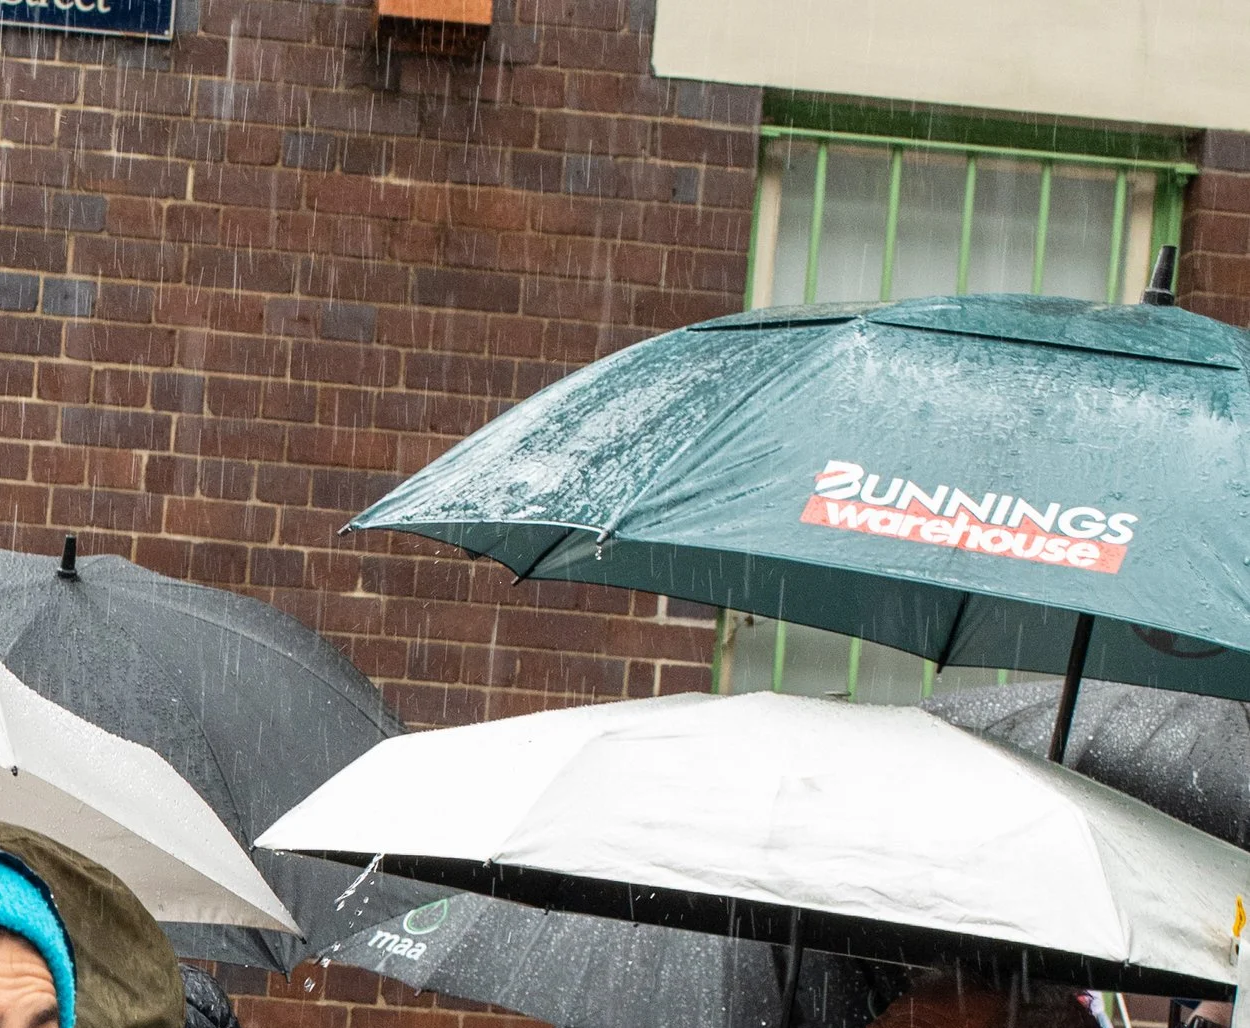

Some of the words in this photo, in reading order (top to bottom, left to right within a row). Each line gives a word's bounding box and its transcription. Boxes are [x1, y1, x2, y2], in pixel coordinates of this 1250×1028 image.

[815, 460, 1139, 545] BUNNINGS
[825, 501, 1101, 567] warehouse
[367, 930, 427, 961] maa
